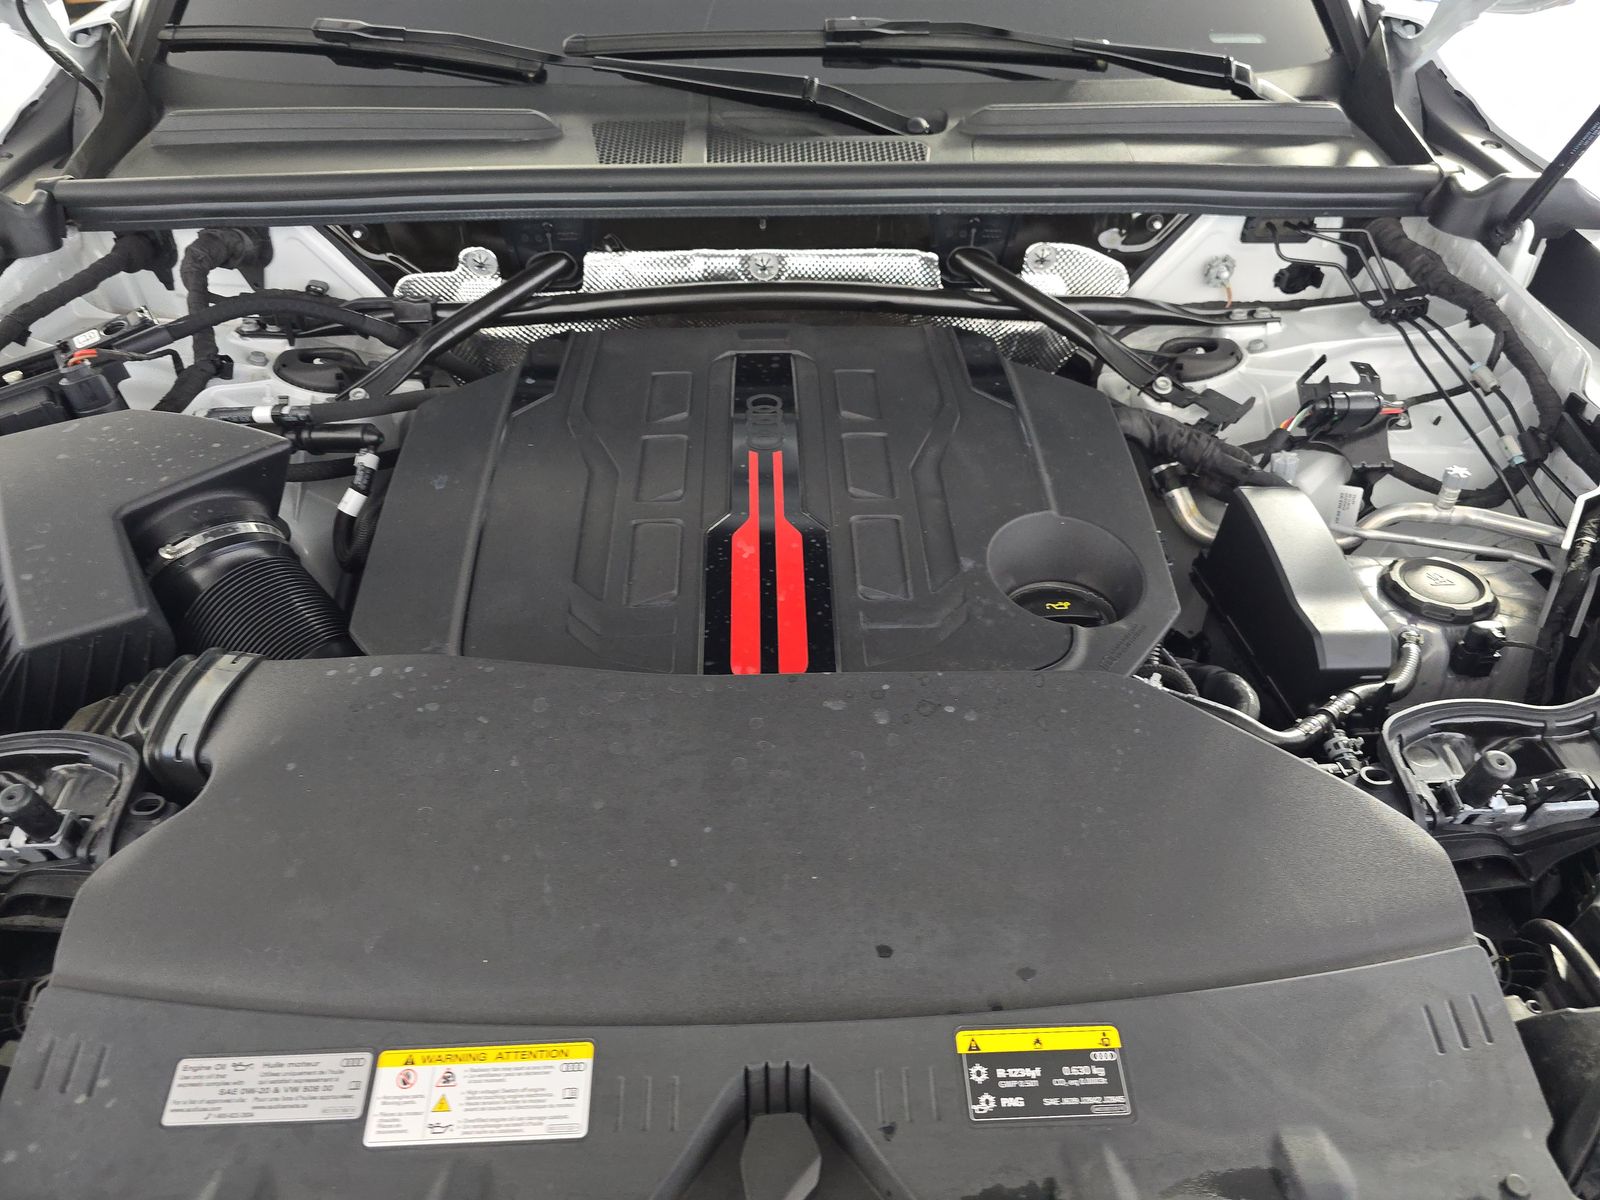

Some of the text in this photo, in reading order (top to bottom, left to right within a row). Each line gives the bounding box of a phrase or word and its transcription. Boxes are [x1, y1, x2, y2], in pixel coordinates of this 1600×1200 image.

[421, 1049, 570, 1064] WARNING ATTENTION
[214, 1063, 227, 1071] Oil
[996, 1067, 1042, 1079] R-1234yf
[218, 1088, 239, 1096] SAE
[1000, 1096, 1025, 1107] PAG
